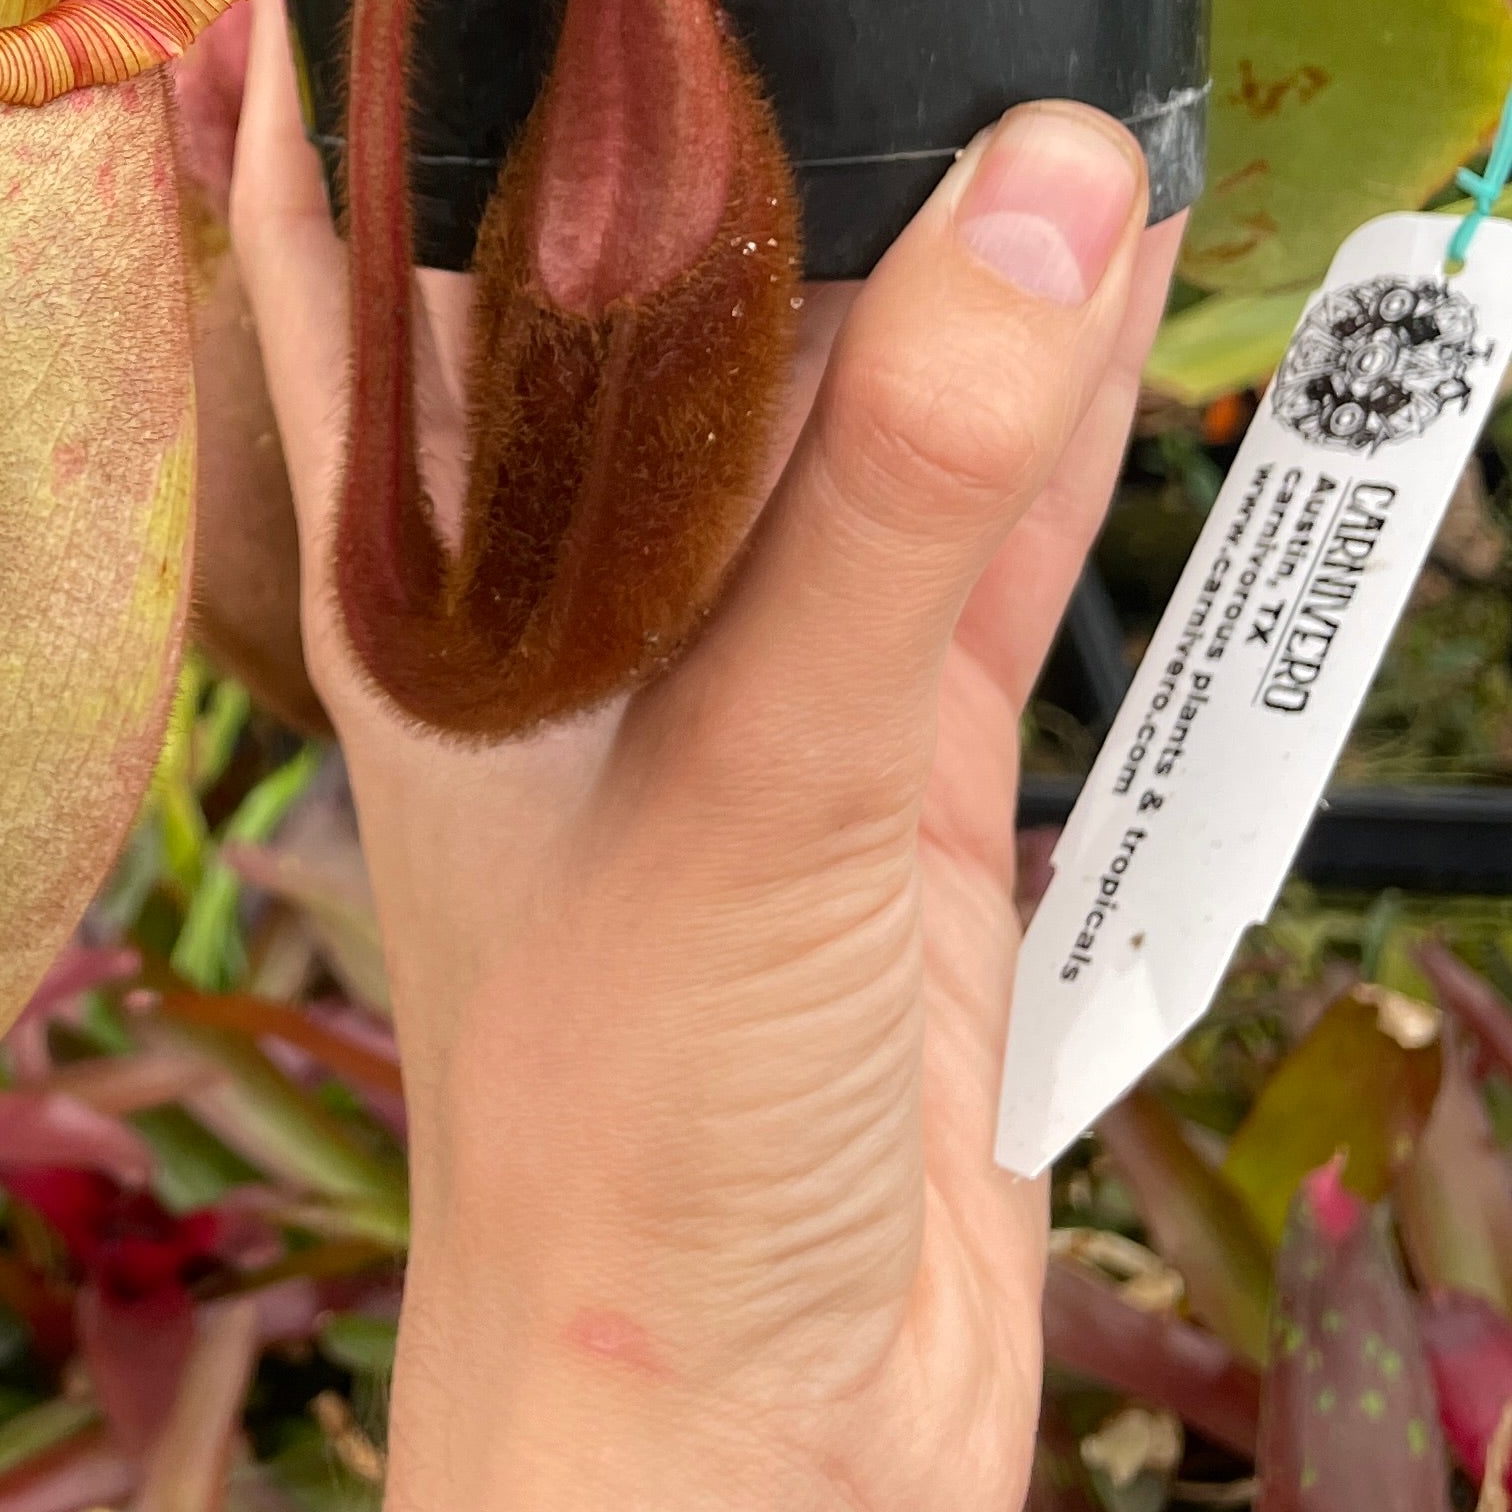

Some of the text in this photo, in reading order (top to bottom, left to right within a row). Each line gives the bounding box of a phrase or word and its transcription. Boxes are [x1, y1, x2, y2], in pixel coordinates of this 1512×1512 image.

[1111, 461, 1278, 796] www.carnivero.com
[1244, 472, 1337, 646] Austin, TX
[1262, 479, 1397, 713] CARNIVERO
[1060, 467, 1303, 984] carnivorous plants & tropicals
